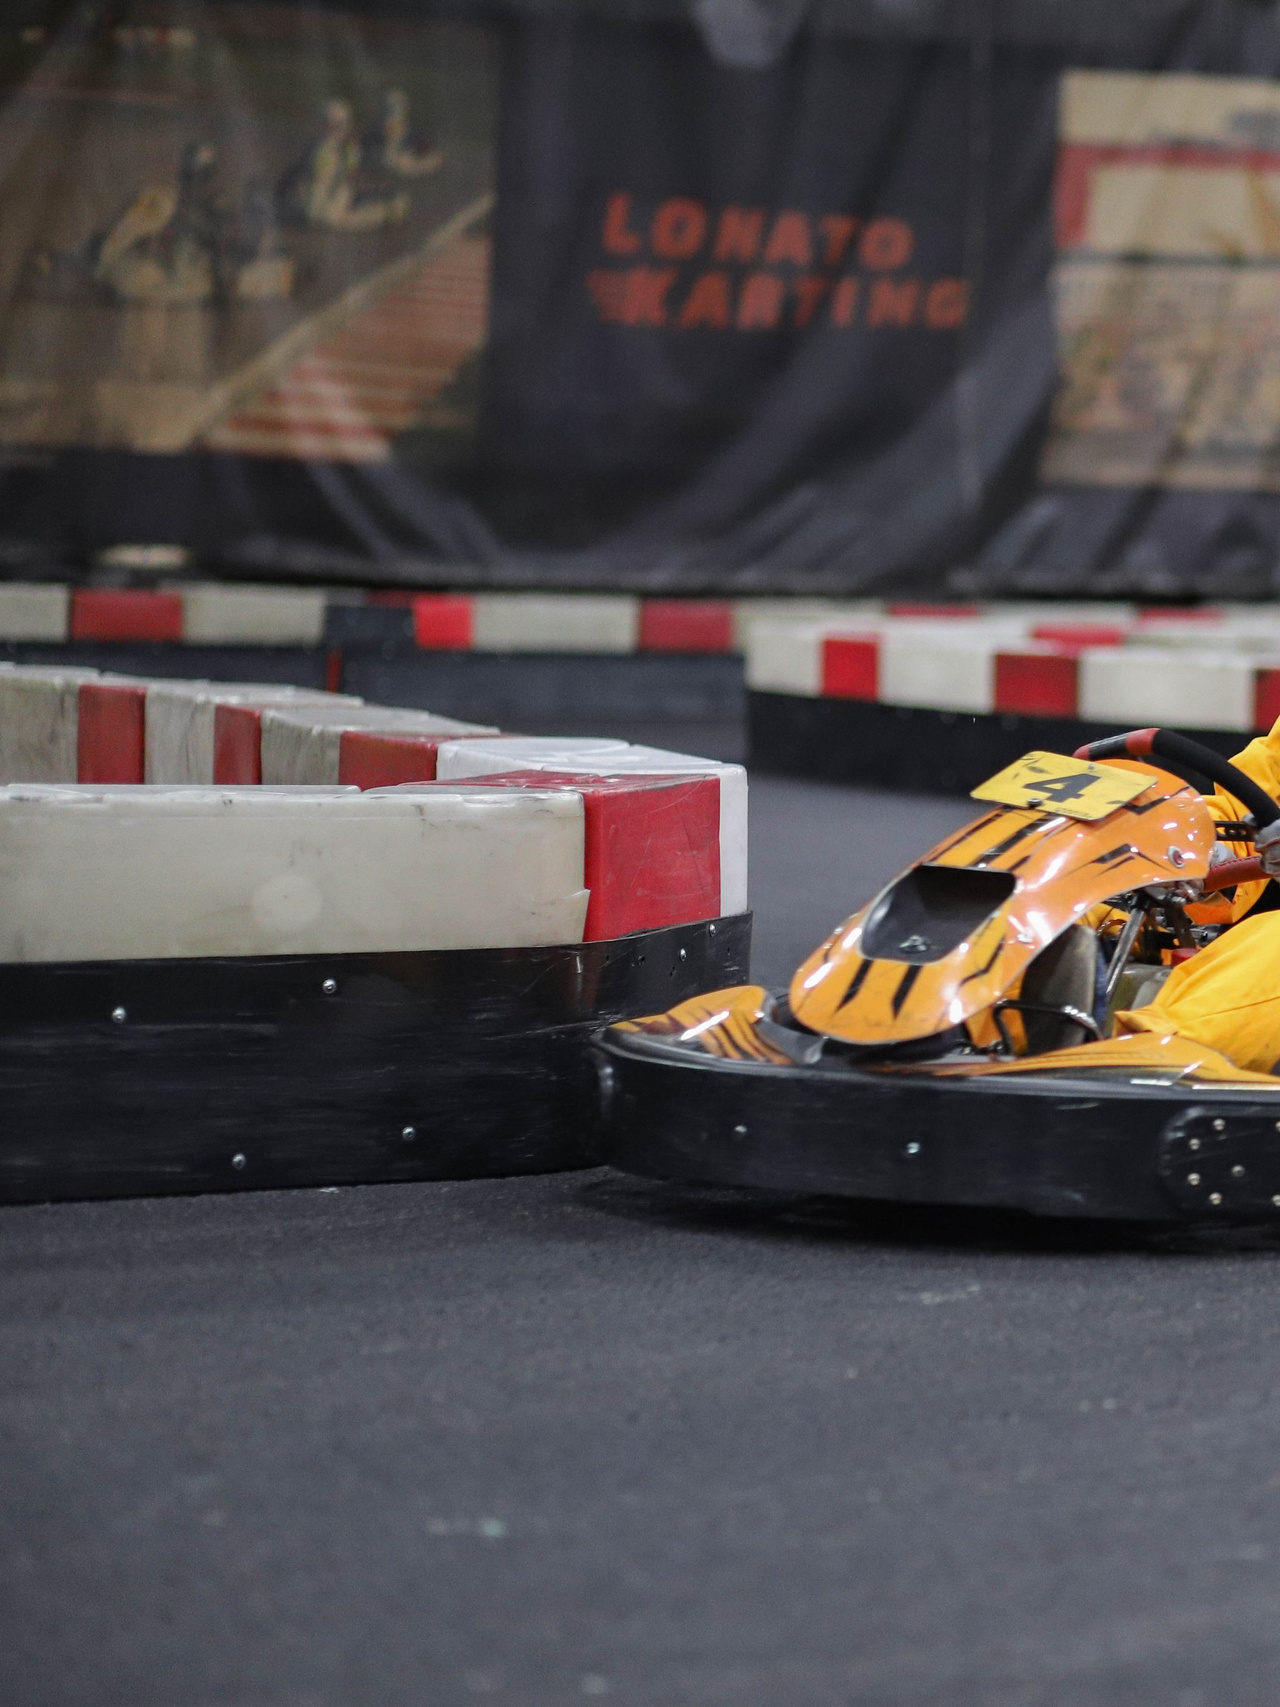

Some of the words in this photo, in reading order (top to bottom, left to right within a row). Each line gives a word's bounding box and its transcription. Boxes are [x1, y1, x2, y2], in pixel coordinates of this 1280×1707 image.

[602, 190, 914, 272] LONATO
[612, 264, 968, 332] KARTING
[1022, 773, 1102, 803] 4
